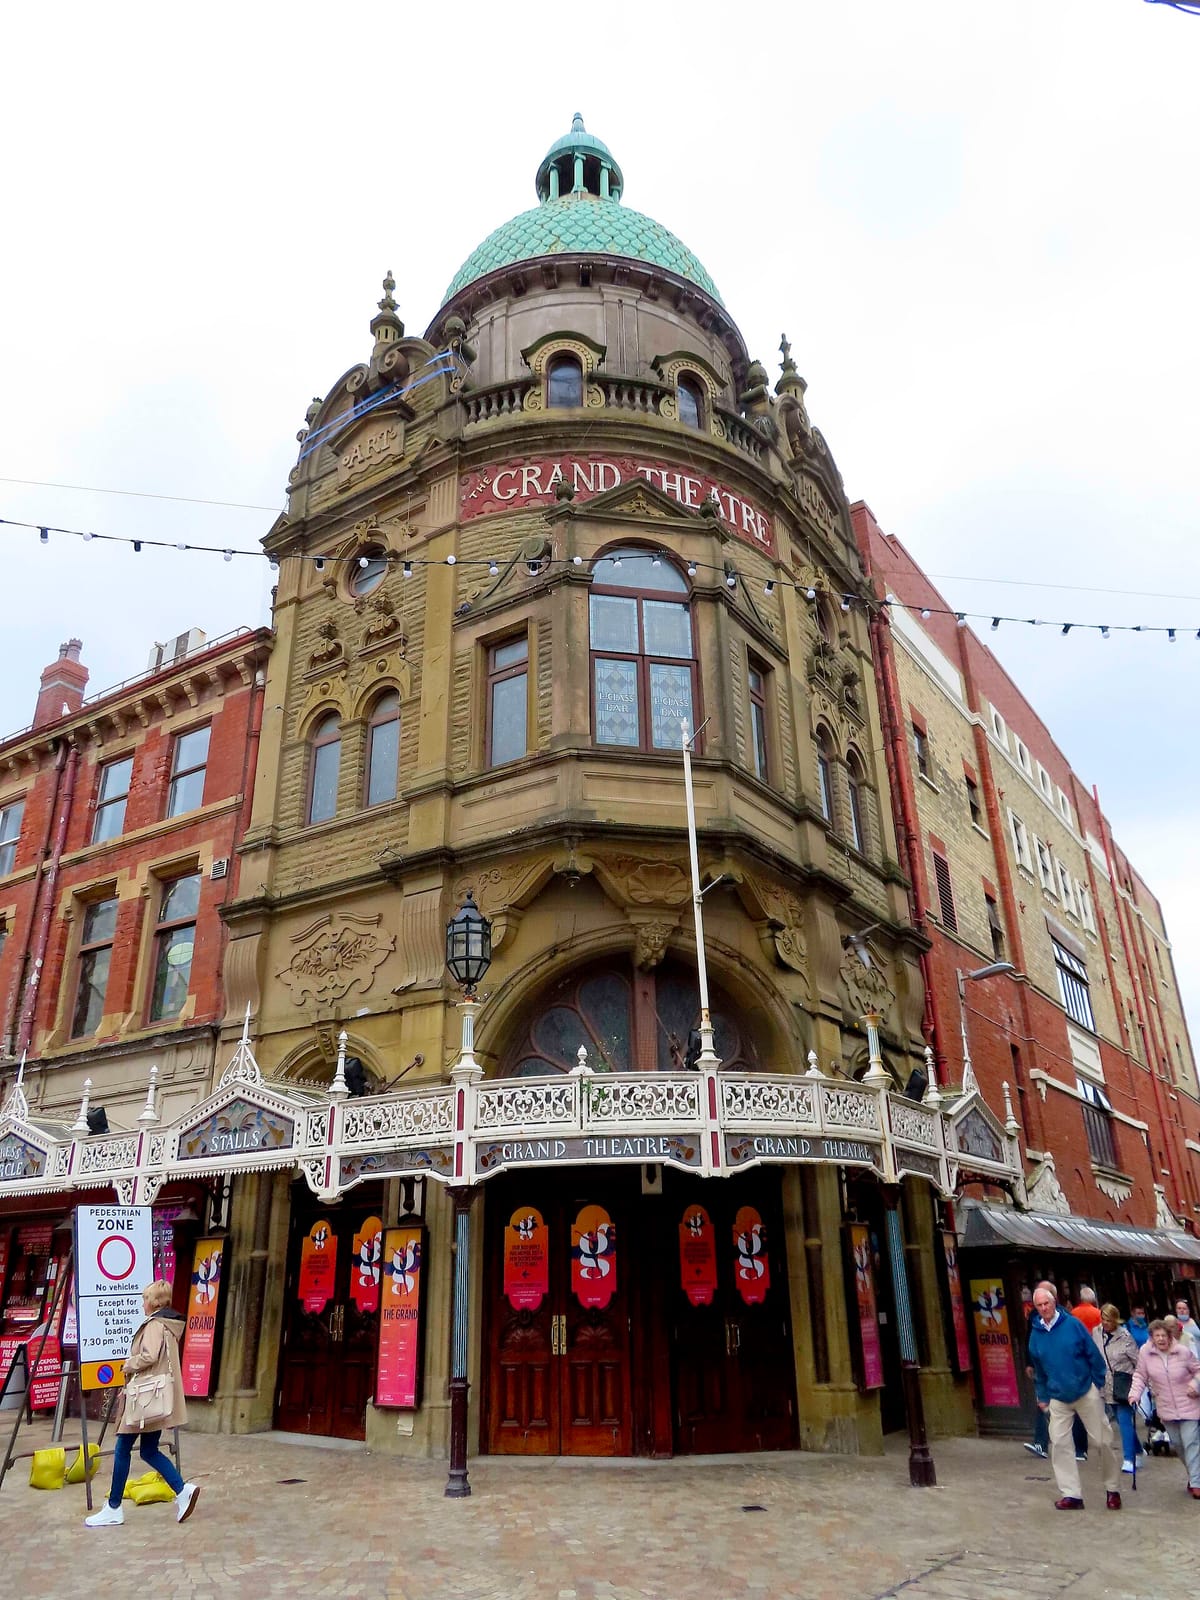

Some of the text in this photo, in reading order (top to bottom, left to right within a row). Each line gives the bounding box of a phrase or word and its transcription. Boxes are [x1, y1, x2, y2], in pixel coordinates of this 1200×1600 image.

[346, 430, 391, 469] ART
[469, 463, 770, 547] THE GRAND THEATRE
[606, 703, 629, 713] BAR
[661, 708, 683, 717] BAR
[210, 1130, 260, 1152] STALLS
[502, 1137, 671, 1160] GRAND THEATRE
[754, 1137, 871, 1159] GRAND THEATRE
[90, 1208, 141, 1216] PEDESTRIAN
[97, 1219, 134, 1231] ZONE
[109, 1282, 139, 1291] vehicles
[98, 1299, 124, 1307] Except
[117, 1307, 139, 1315] buses
[383, 1308, 417, 1320] THE GRAND
[189, 1316, 214, 1330] GRAND
[105, 1327, 132, 1335] loading
[82, 1337, 101, 1346] 7.30
[980, 1334, 1008, 1345] GRAND
[112, 1347, 128, 1355] only
